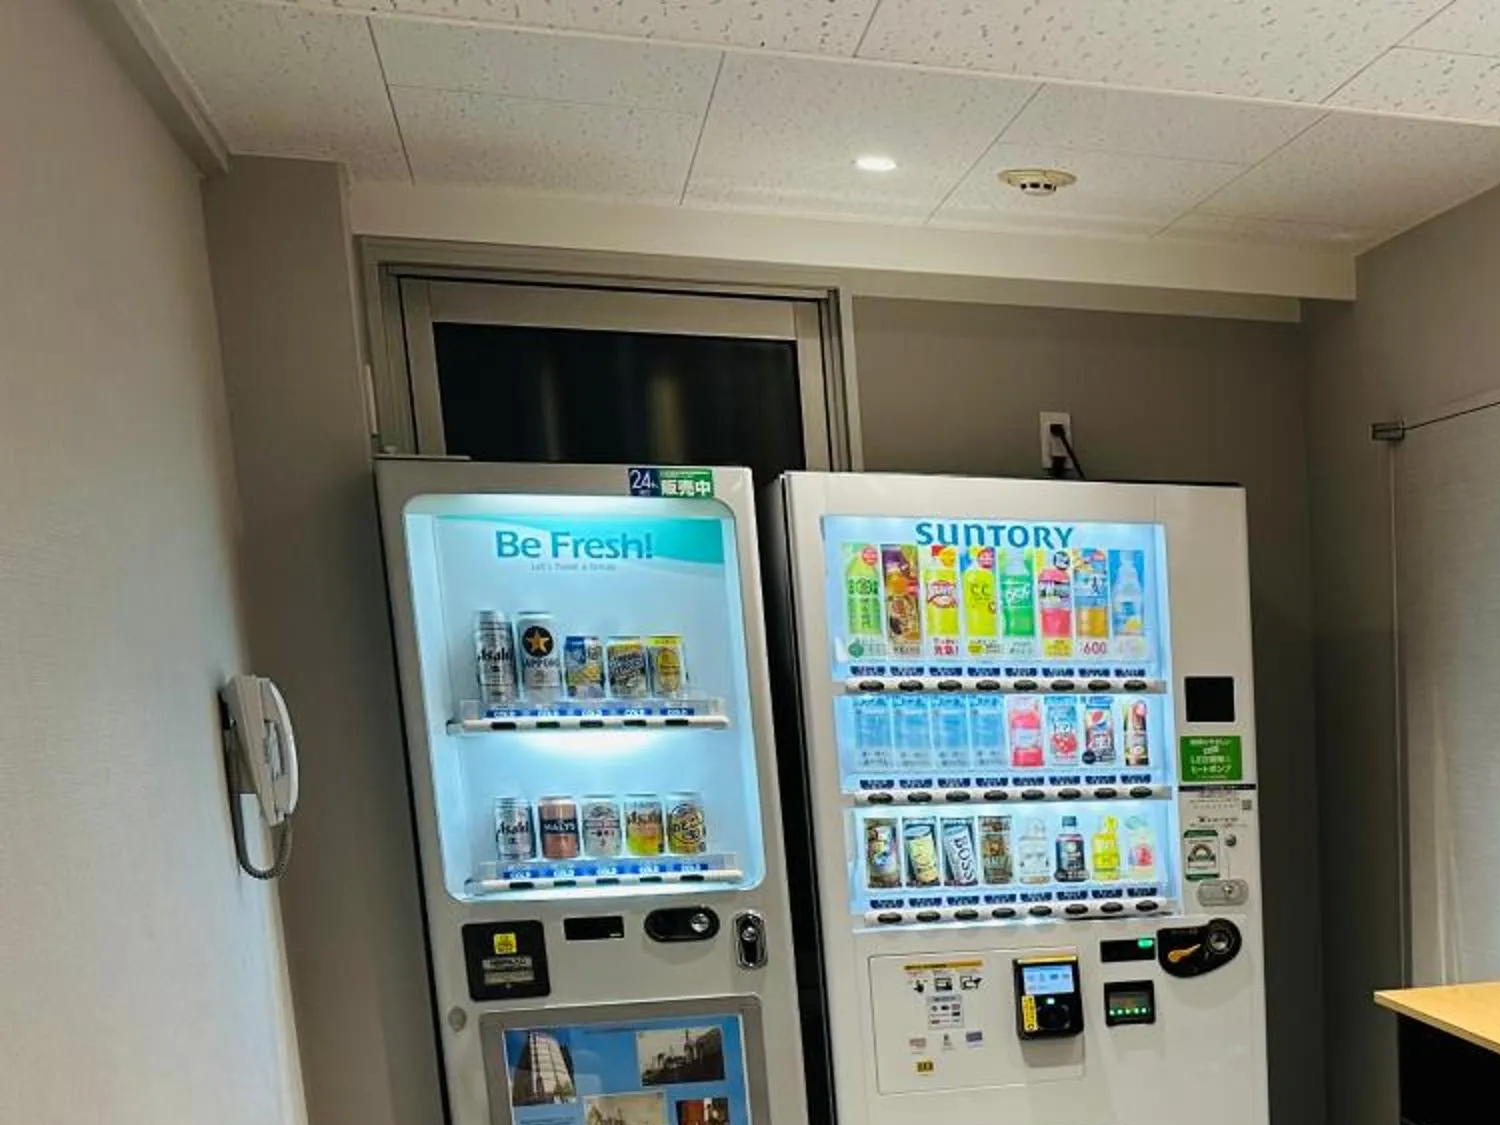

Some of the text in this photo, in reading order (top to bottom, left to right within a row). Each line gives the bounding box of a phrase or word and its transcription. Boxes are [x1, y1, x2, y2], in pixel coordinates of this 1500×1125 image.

[660, 479, 712, 498] 販売中
[495, 529, 654, 560] Be Fresh!
[915, 521, 1074, 549] SUNTORY
